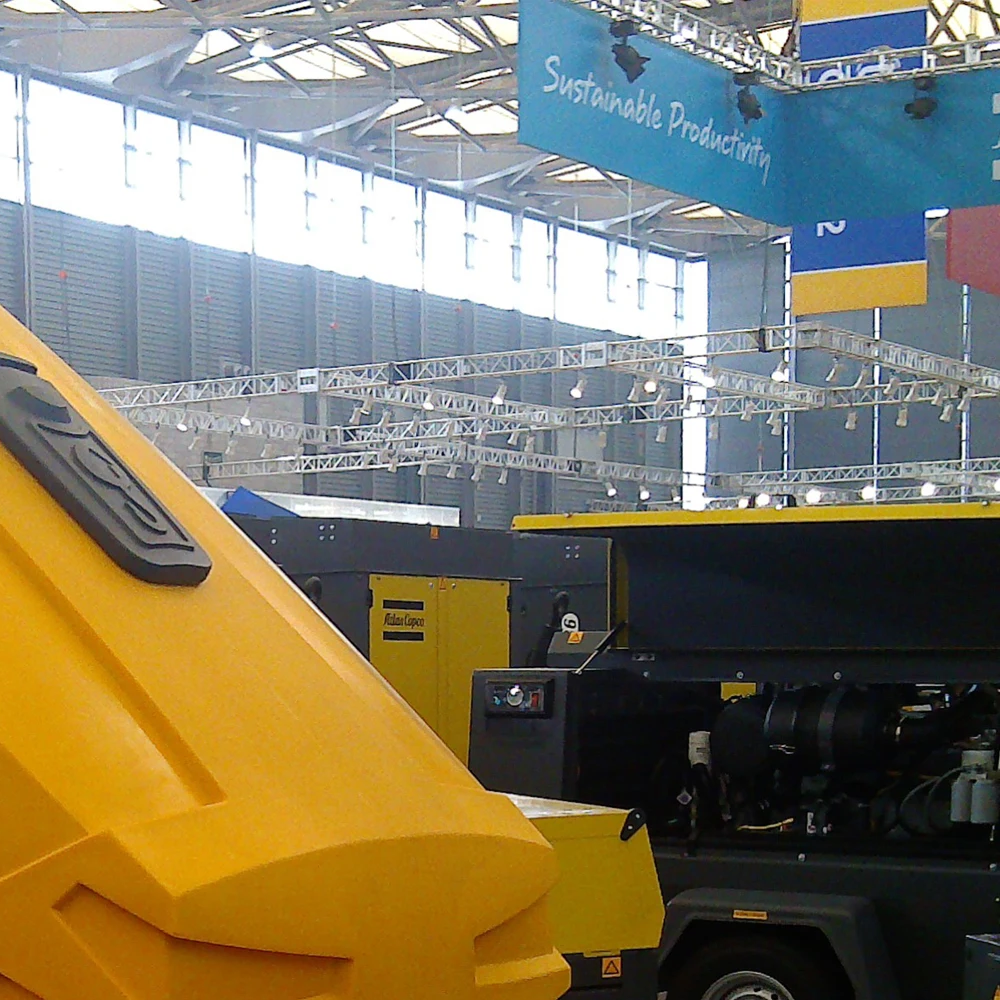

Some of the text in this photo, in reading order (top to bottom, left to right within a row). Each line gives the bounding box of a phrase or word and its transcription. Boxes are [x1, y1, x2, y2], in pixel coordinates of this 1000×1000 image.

[543, 55, 771, 186] Sustainable Productivity
[383, 612, 425, 629] Atlas Copco
